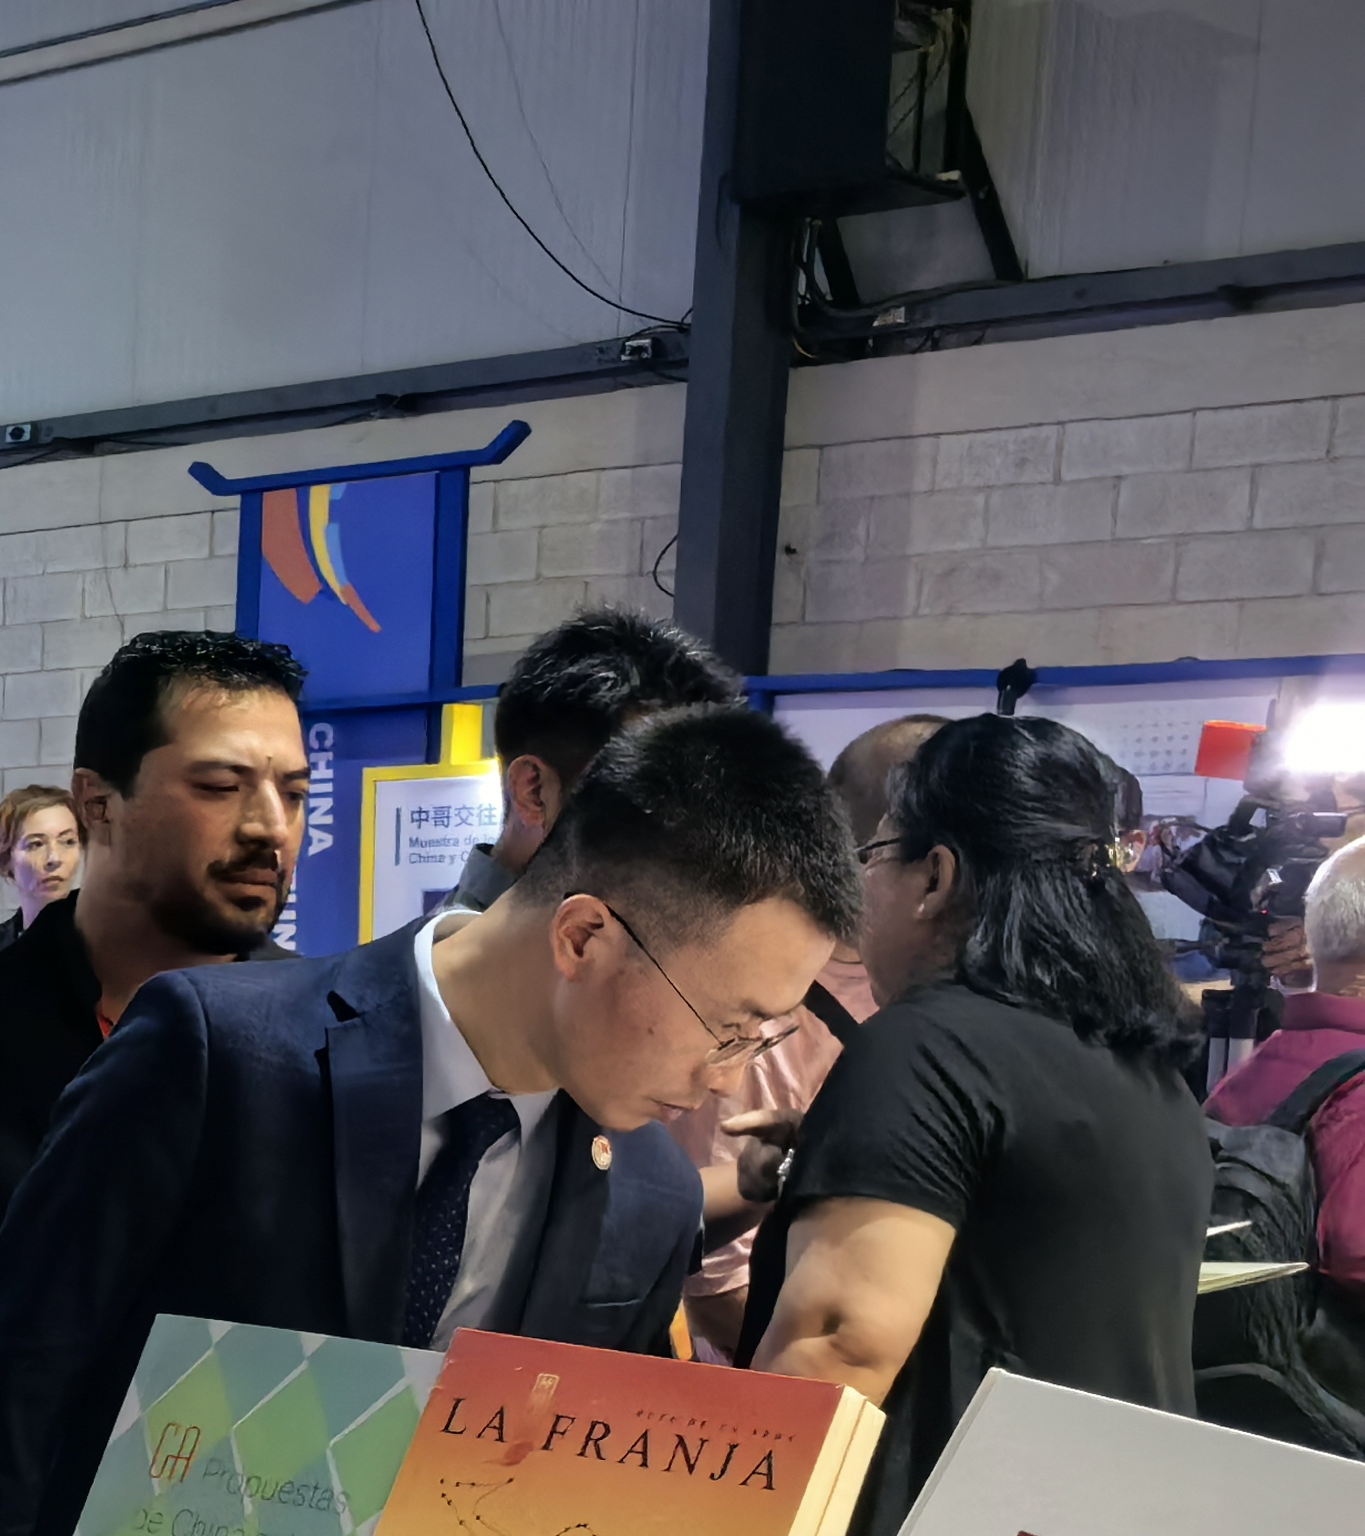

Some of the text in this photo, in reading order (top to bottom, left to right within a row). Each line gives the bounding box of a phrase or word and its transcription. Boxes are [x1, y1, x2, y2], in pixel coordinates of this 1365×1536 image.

[307, 722, 334, 857] CHINA
[440, 1398, 511, 1445] LA
[540, 1413, 777, 1491] FRANJA
